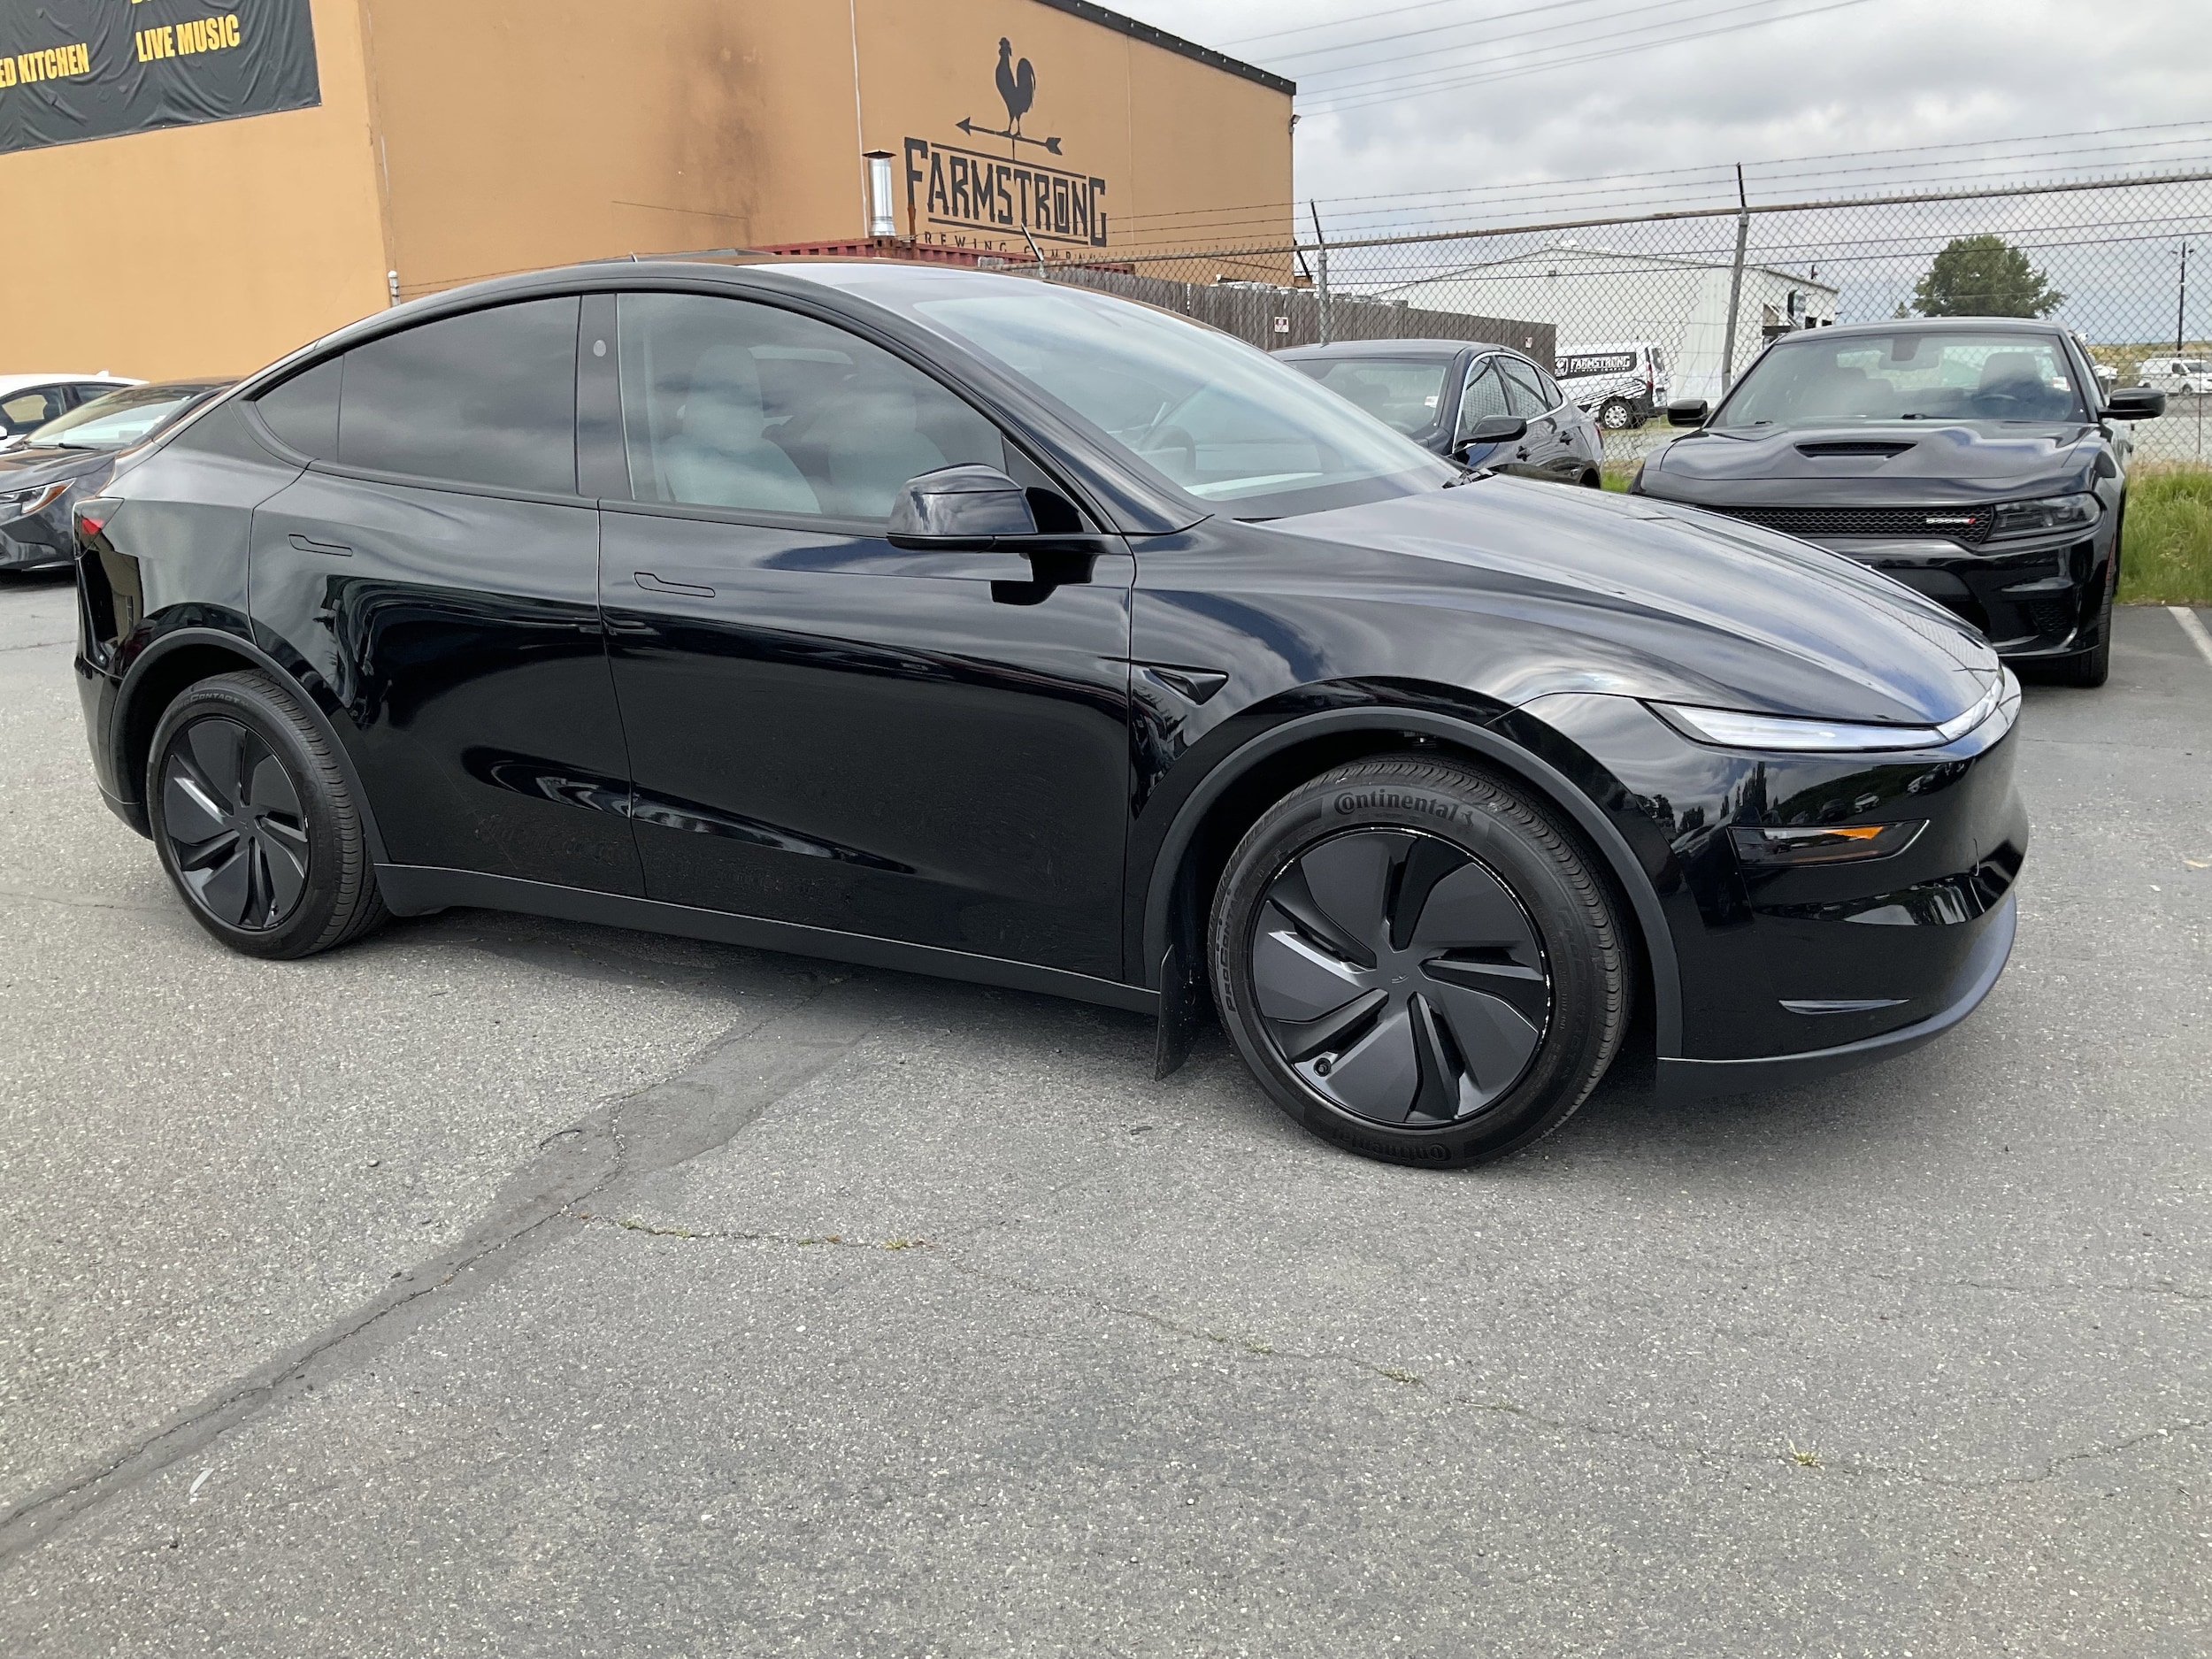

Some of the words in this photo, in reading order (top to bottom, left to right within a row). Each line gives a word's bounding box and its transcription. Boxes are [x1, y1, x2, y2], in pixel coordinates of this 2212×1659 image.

[135, 26, 175, 62] LIVE
[176, 14, 240, 55] MUSIC
[18, 42, 89, 83] KITCHEN
[904, 137, 1106, 247] FARMSTRONG
[924, 231, 1007, 252] REWING
[1571, 356, 1630, 369] FARMSTRONG
[1334, 788, 1459, 822] Continental
